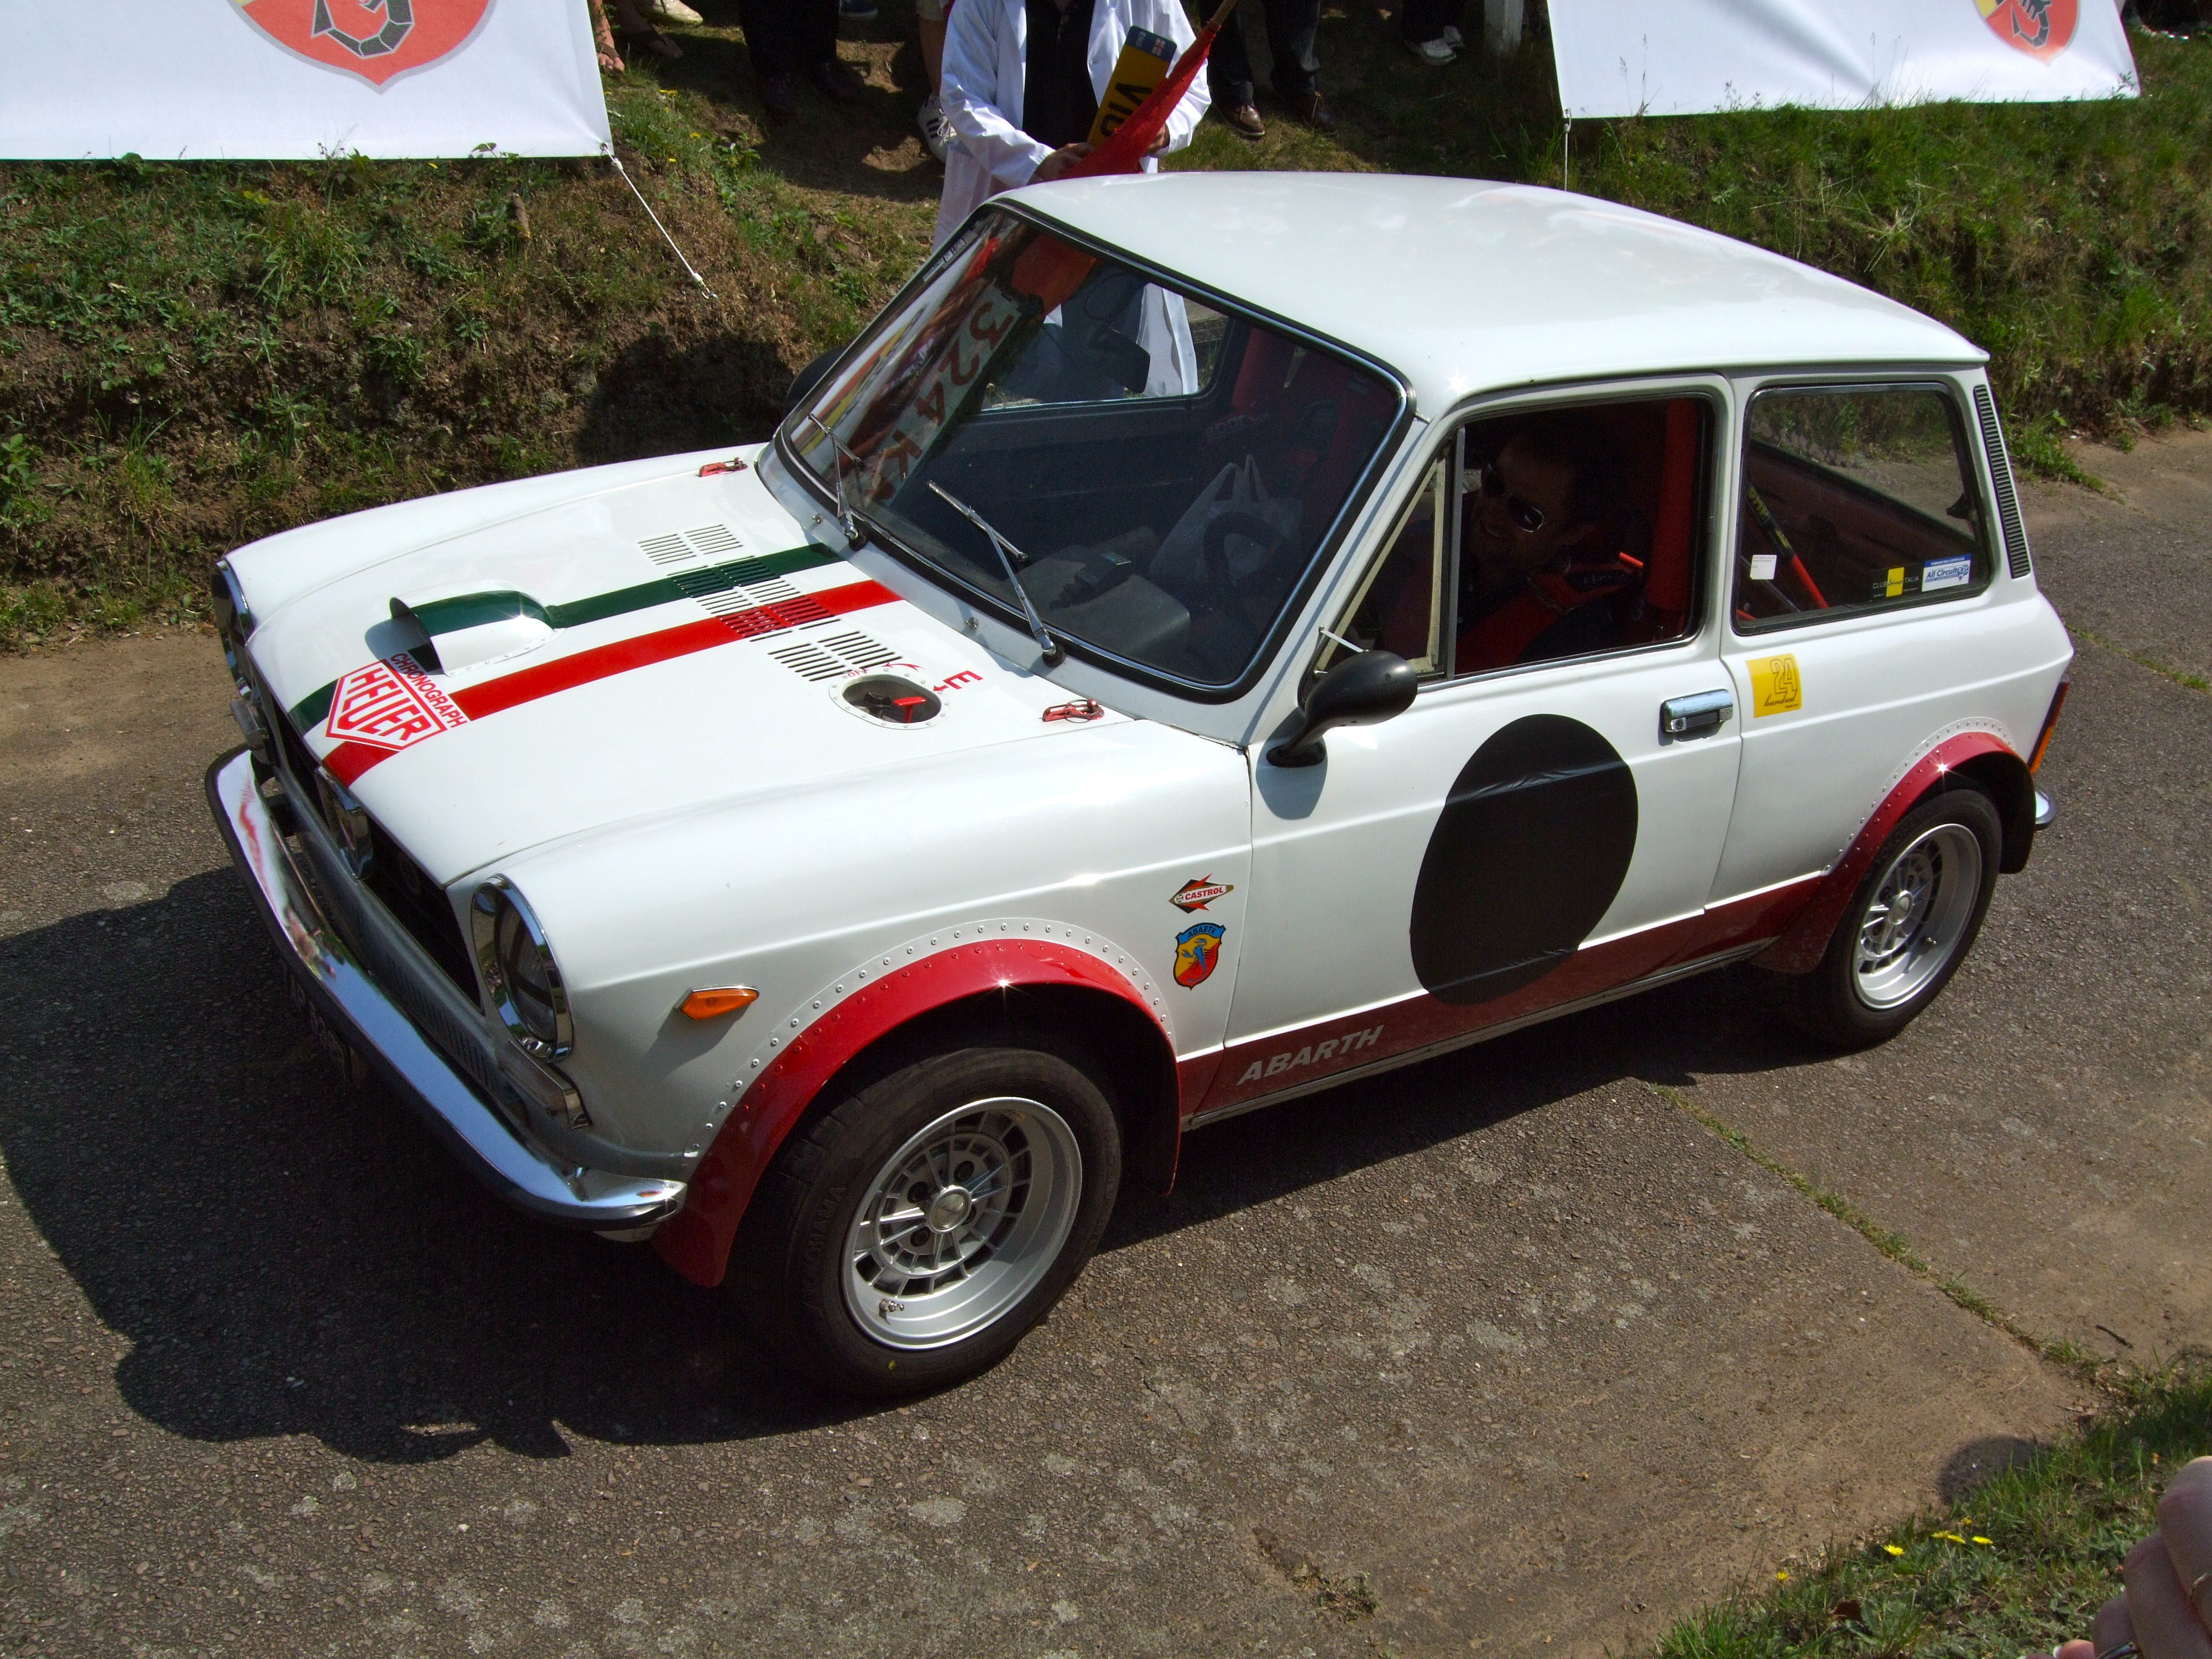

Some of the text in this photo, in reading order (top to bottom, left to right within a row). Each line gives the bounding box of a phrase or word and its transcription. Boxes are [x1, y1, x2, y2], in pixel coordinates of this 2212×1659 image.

[1926, 570, 1936, 578] All
[1770, 658, 1798, 695] 24
[390, 653, 468, 728] CHRONOGRAPH
[1764, 693, 1796, 707] hundred
[336, 667, 432, 741] HEUER
[1185, 886, 1224, 901] CASTROL
[1187, 924, 1217, 939] ABARTH
[1236, 1024, 1385, 1086] ABARTH
